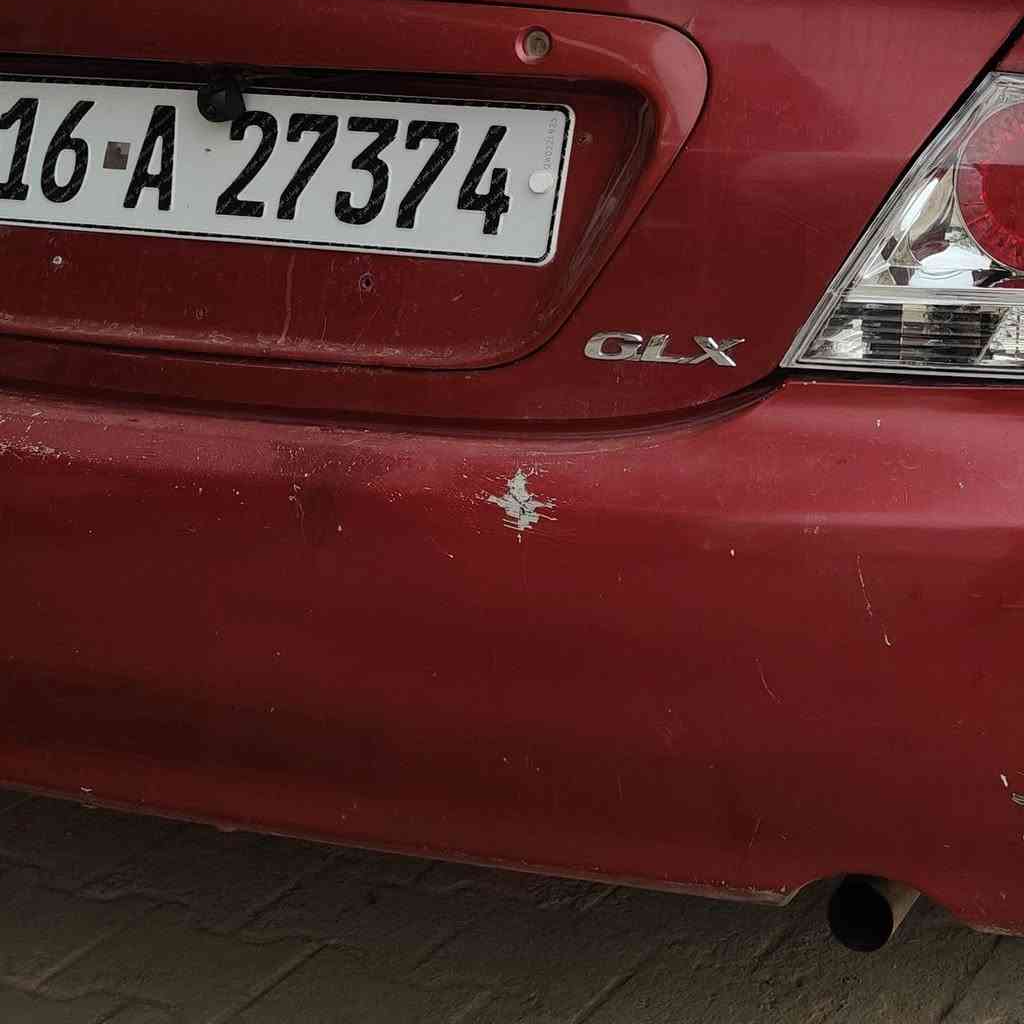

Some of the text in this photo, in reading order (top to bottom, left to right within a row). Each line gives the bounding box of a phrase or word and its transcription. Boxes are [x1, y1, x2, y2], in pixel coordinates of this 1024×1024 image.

[0, 97, 511, 236] 16 A 27374
[584, 332, 746, 368] GLX
